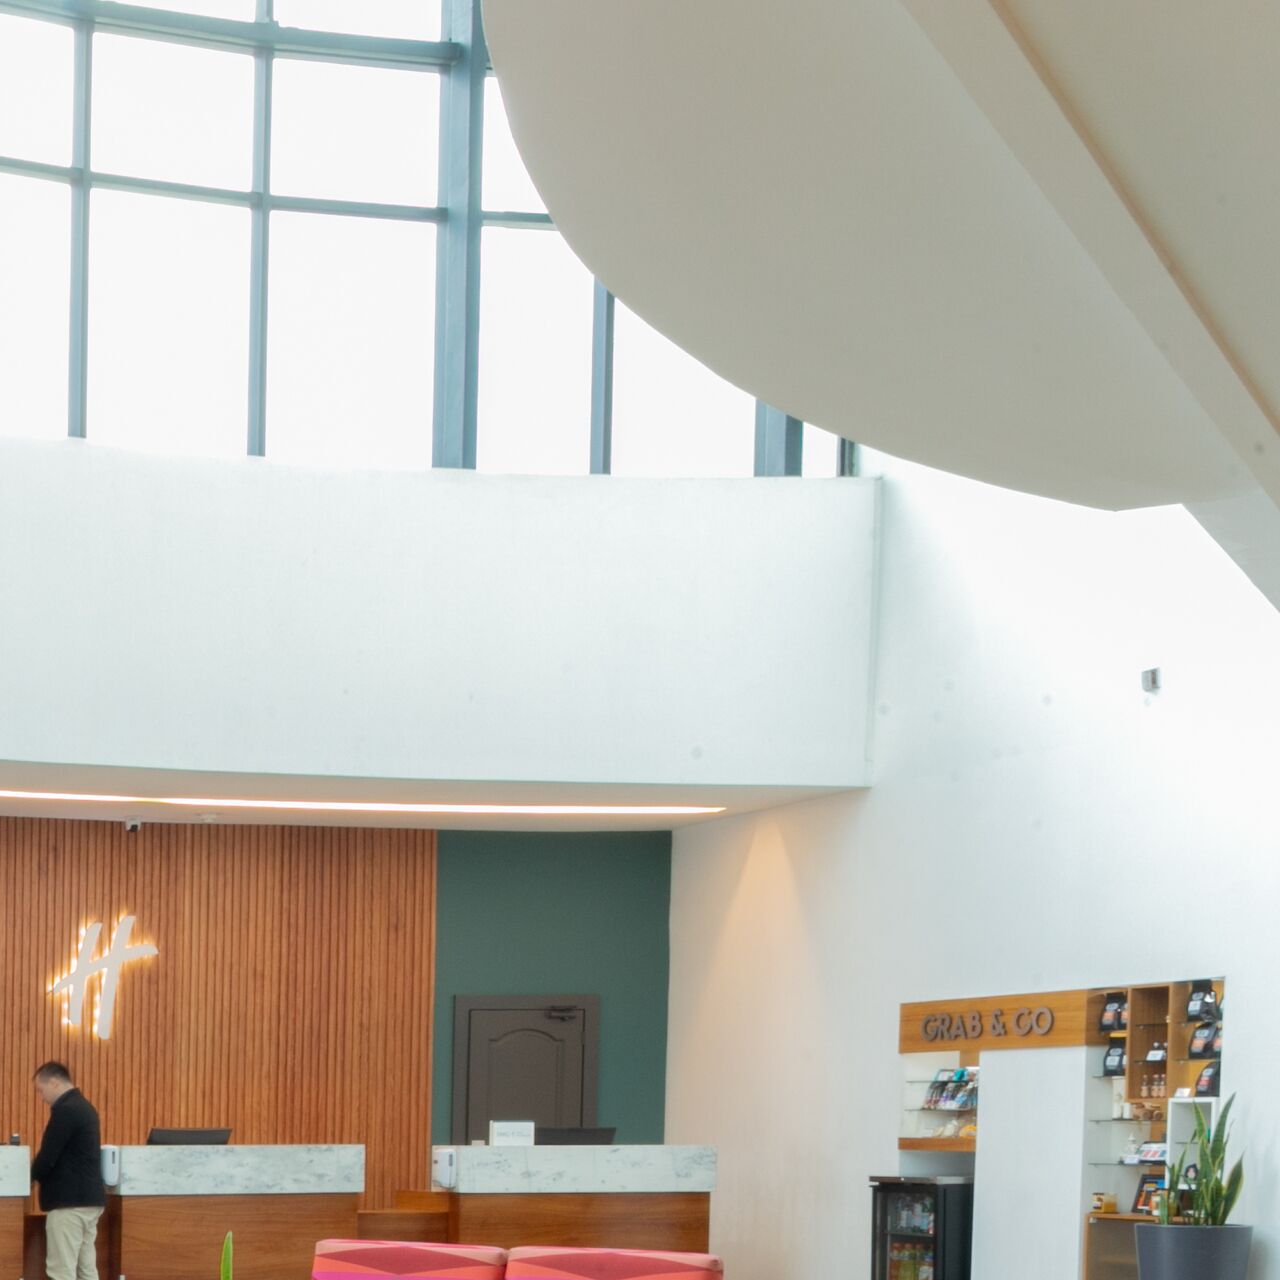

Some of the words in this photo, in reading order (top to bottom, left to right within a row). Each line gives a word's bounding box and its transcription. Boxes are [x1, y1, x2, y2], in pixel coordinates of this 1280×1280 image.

[921, 1011, 983, 1041] GRAB
[991, 1008, 1007, 1036] &
[1013, 1007, 1054, 1036] GO
